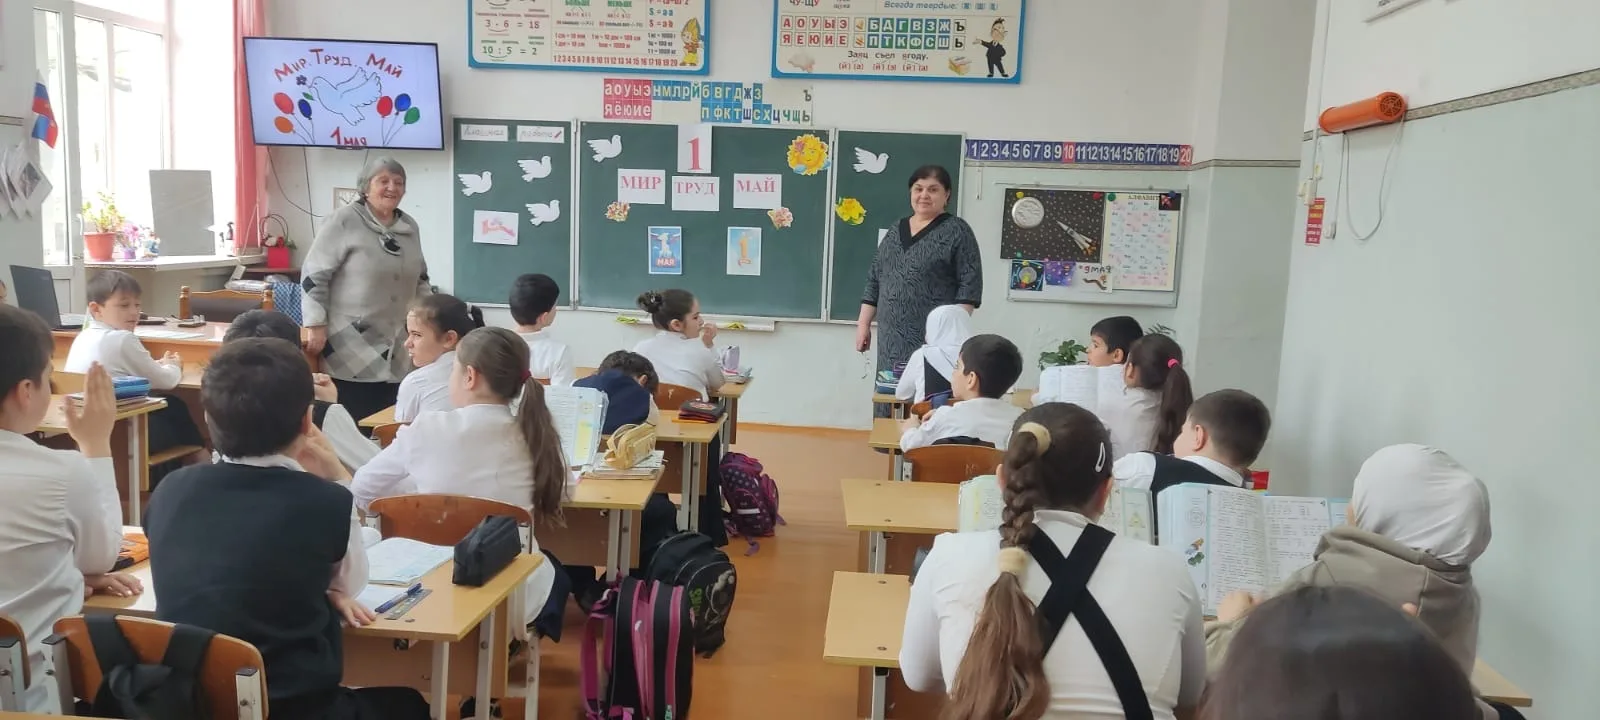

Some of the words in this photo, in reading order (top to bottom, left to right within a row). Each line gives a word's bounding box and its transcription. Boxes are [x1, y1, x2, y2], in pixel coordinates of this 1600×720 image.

[688, 137, 703, 171] 1
[971, 143, 977, 157] 1
[981, 143, 989, 158] 2
[991, 144, 999, 158] 3
[1001, 144, 1010, 158] 4
[1012, 144, 1020, 158] 5
[1022, 144, 1030, 159] 6
[1034, 144, 1041, 159] 7
[1044, 145, 1051, 159] 8
[1054, 145, 1062, 160] 9
[1064, 145, 1074, 160] 10
[1076, 146, 1086, 160] 11
[1087, 146, 1098, 160] 12
[1100, 146, 1109, 161] 13
[1110, 146, 1121, 161] 14
[1122, 146, 1133, 161] 15
[1134, 147, 1145, 162] 16
[1146, 147, 1157, 162] 17
[1158, 147, 1168, 162] 18
[1169, 147, 1179, 163] 19
[1181, 148, 1192, 163] 20
[621, 176, 662, 190] МИР
[675, 182, 715, 196] ТРУД
[736, 176, 776, 193] МАЙ
